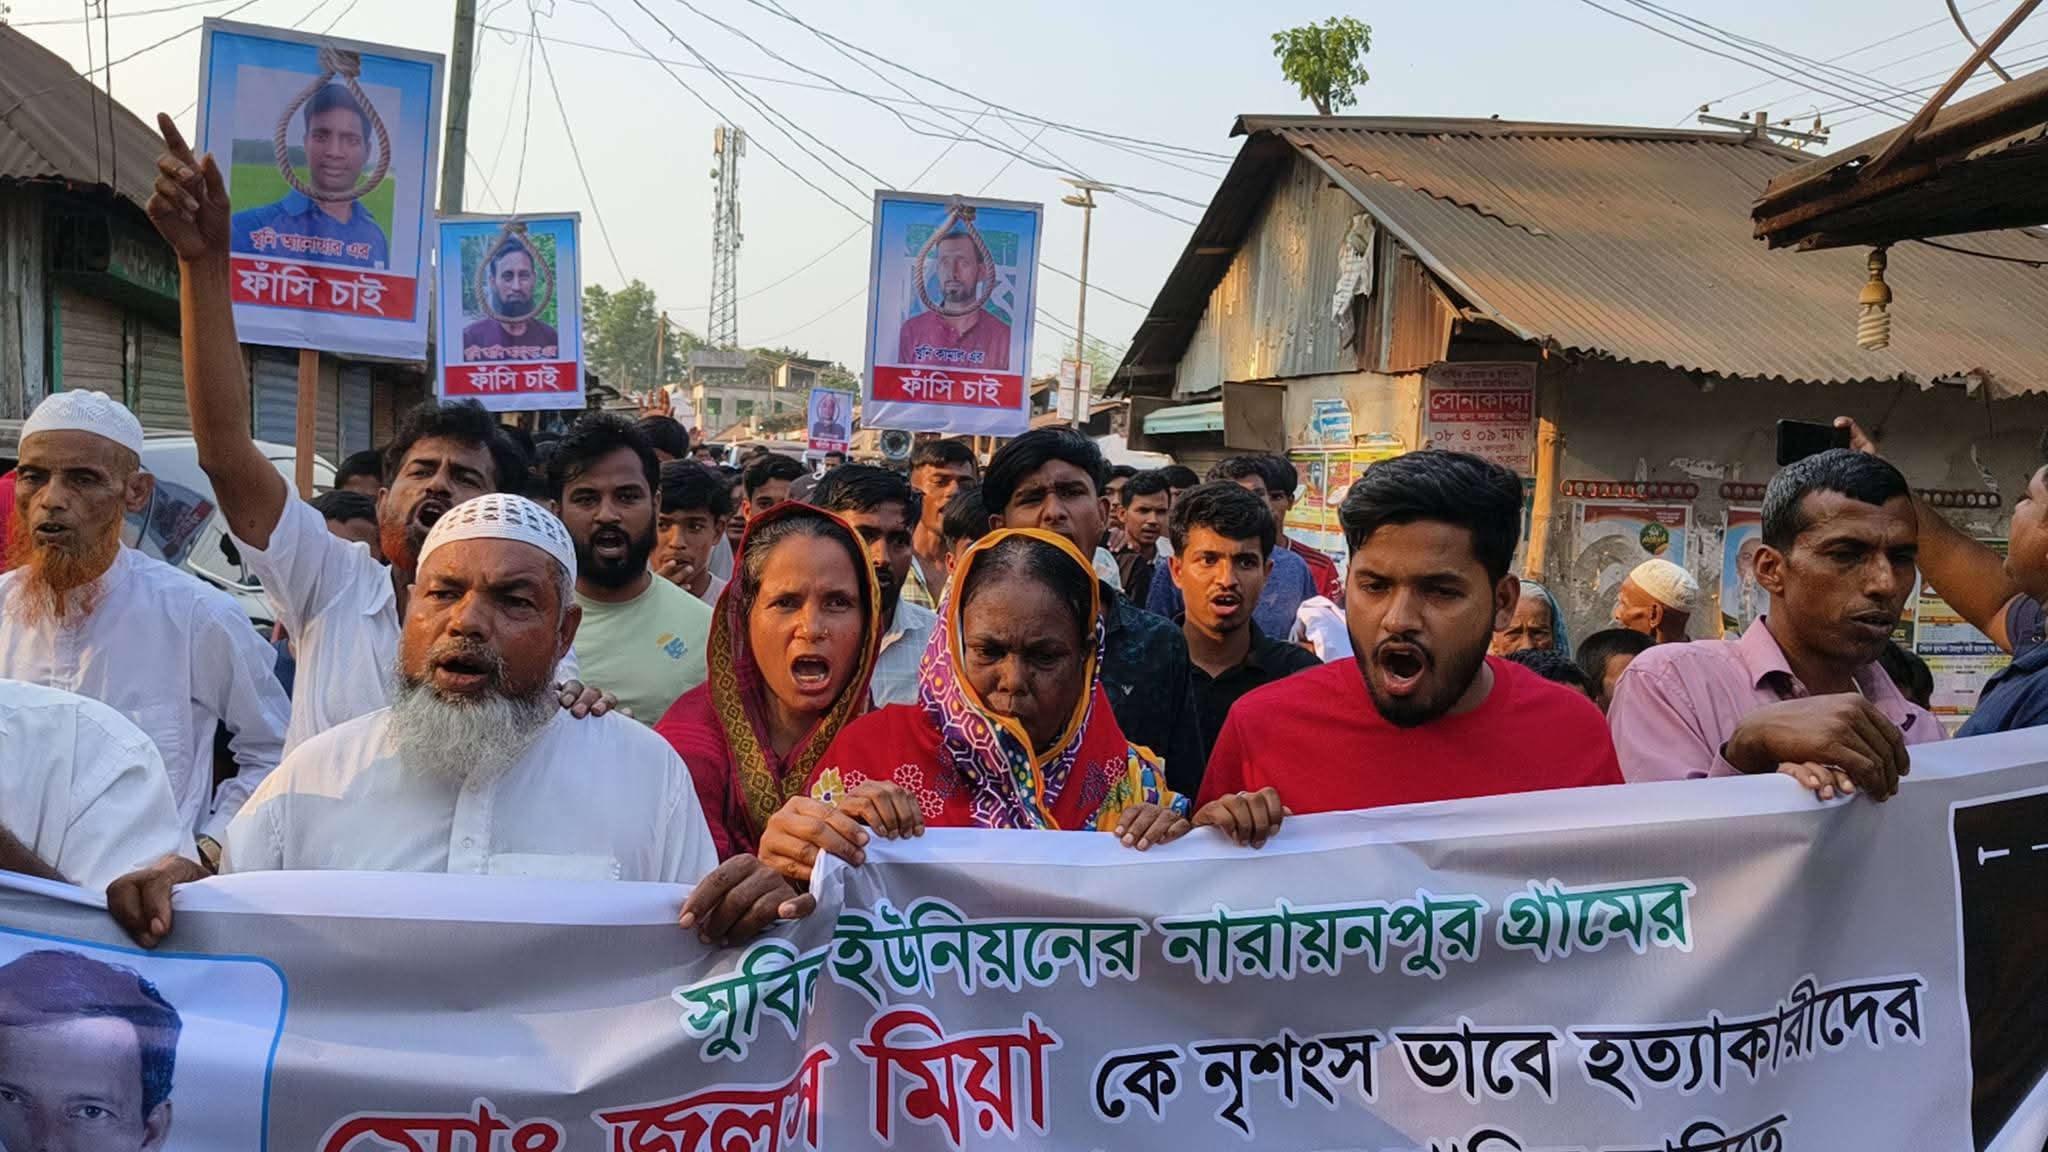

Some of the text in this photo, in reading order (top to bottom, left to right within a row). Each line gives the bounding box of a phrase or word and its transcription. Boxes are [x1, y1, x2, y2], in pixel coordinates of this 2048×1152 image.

[237, 261, 388, 316] ফাঁসি চাই
[467, 364, 561, 391] ফাঁসি চাই
[899, 369, 1003, 406] ফাঁসি চাই
[1431, 391, 1531, 410] সোনাকান্দা
[1434, 428, 1527, 441] ০৮ ও ০৯ মাঘ
[831, 901, 1144, 1005] ইউনিয়নের
[1160, 895, 1483, 977] নারায়নপুর
[1501, 882, 1690, 955] গ্রামের
[856, 1010, 1057, 1146] মিয়া
[1097, 1048, 1181, 1116] কে
[1194, 1032, 1381, 1134] নৃশংস
[1394, 1022, 1558, 1099] ভাবে
[1572, 978, 1924, 1103] হত্যাকারীদের
